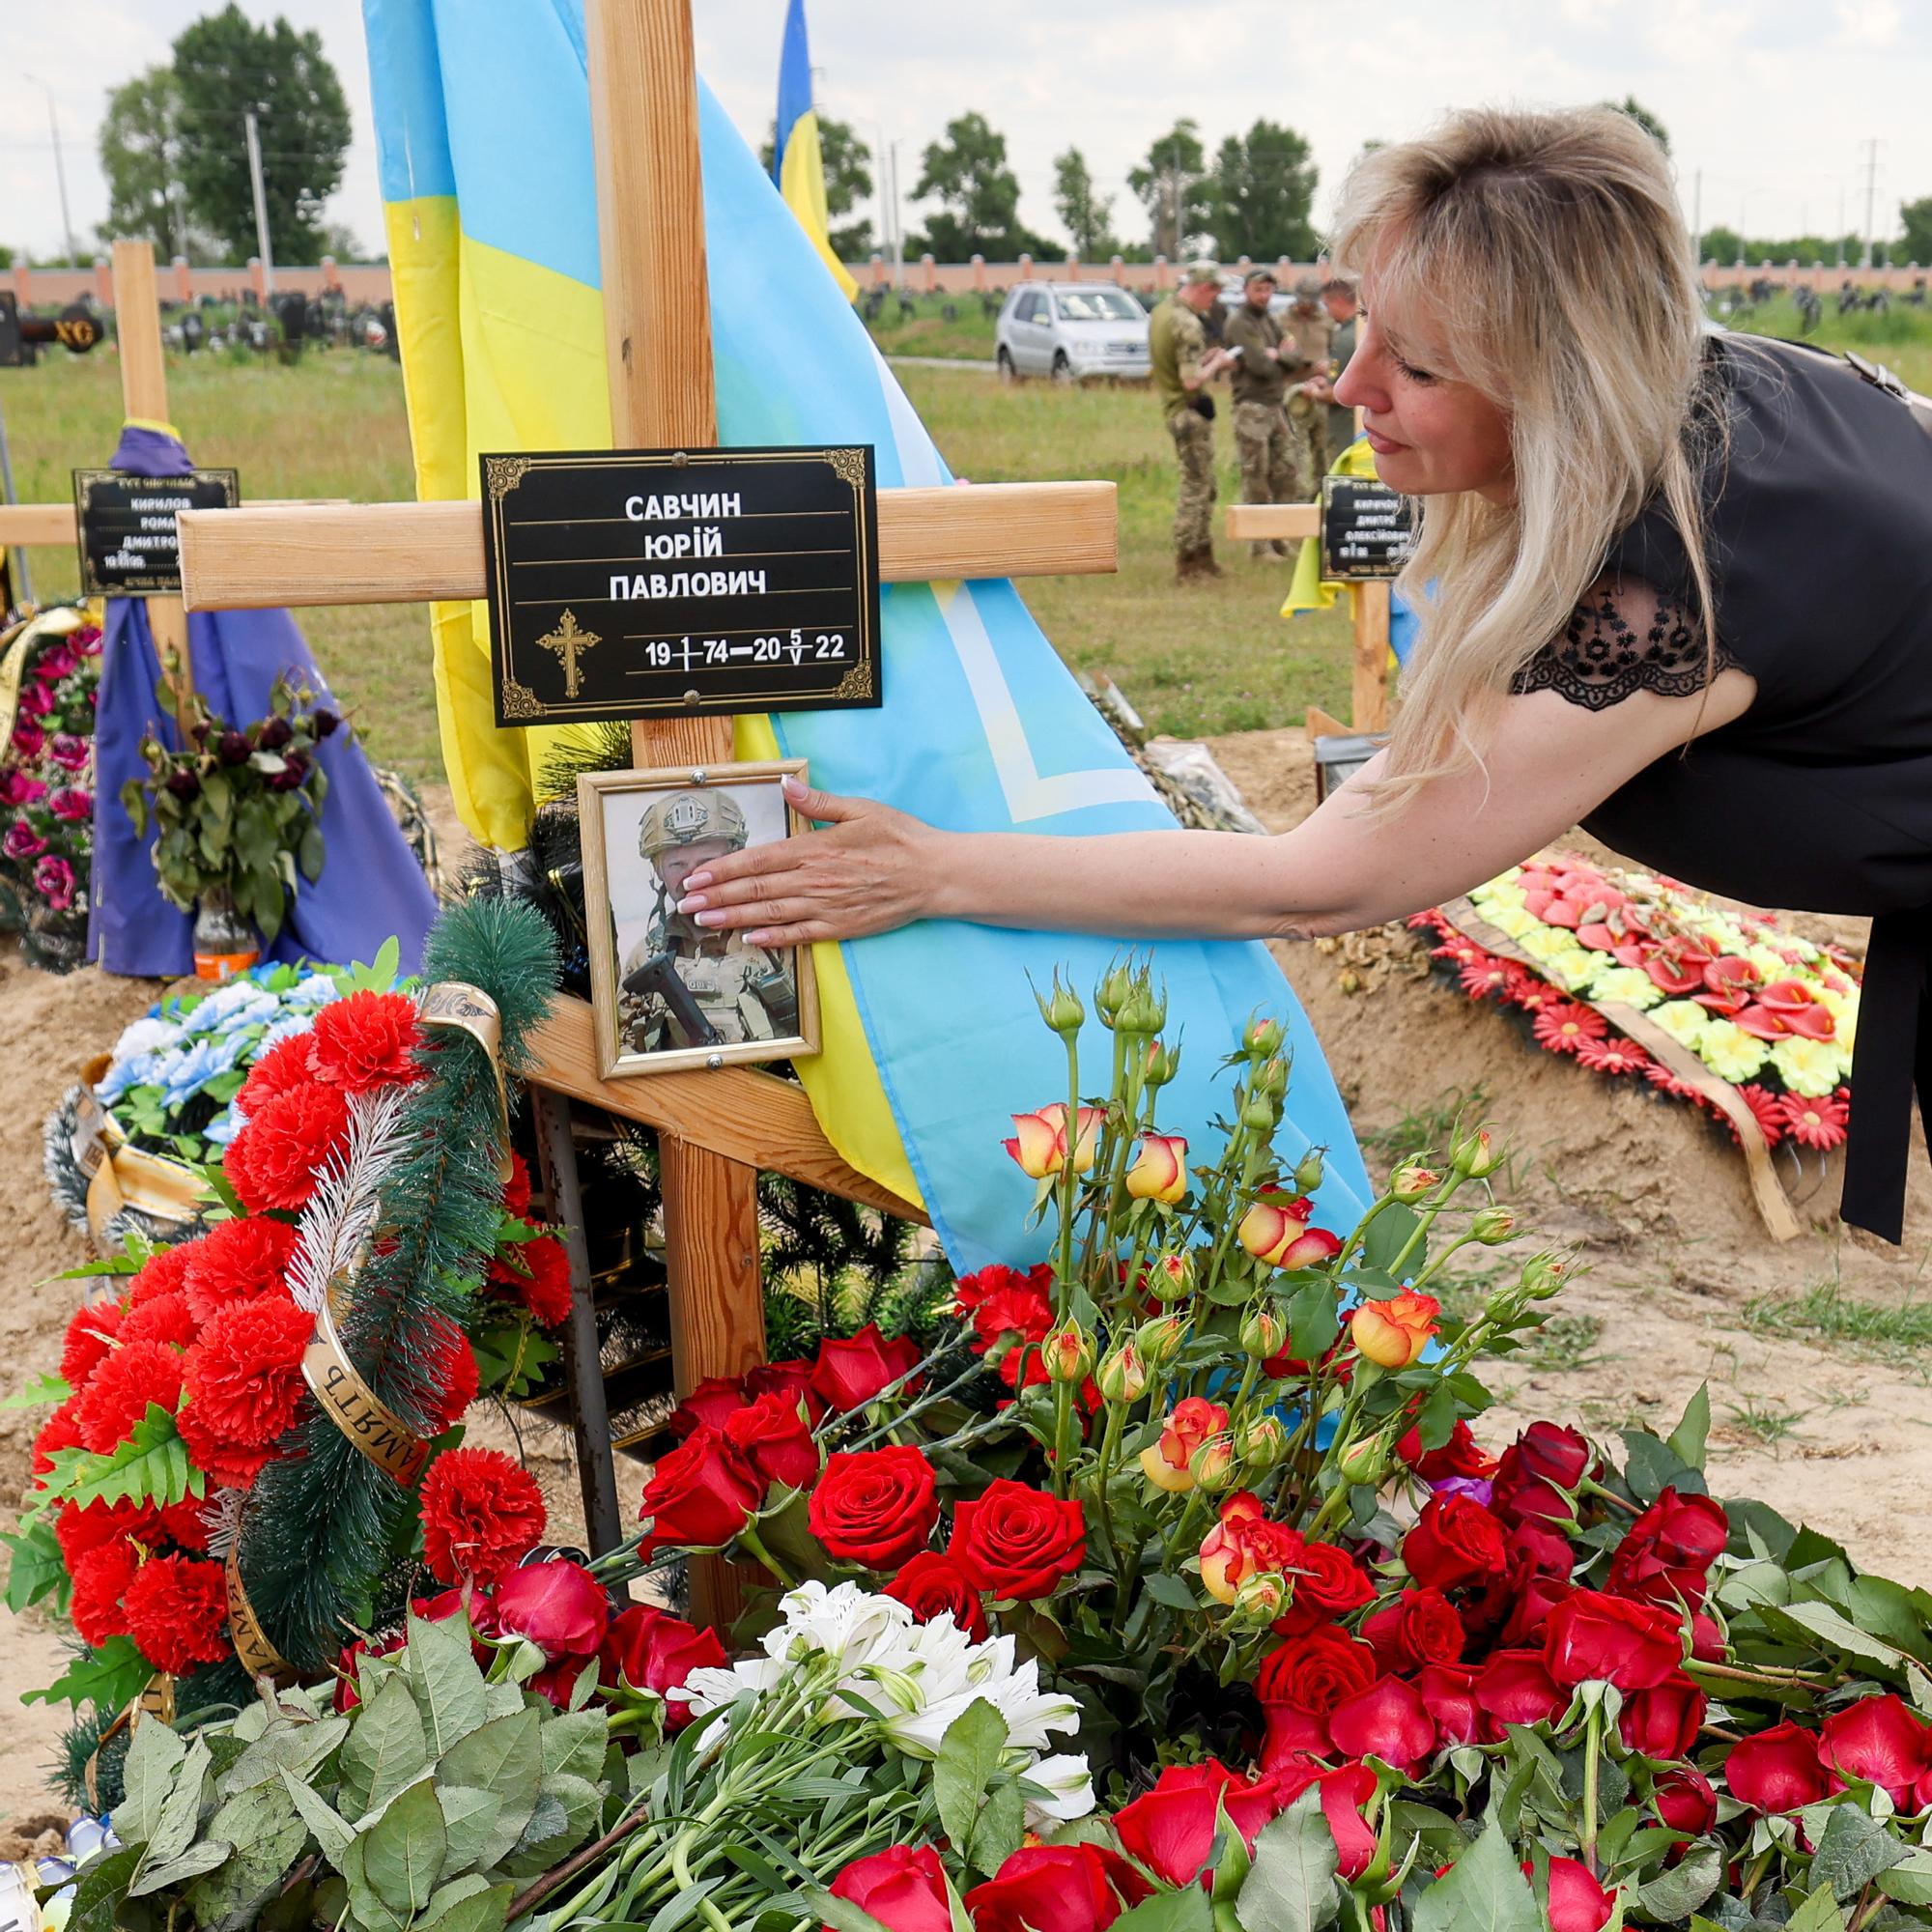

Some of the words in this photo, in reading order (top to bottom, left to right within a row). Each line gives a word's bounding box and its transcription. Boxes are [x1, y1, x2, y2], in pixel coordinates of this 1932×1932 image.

[130, 497, 192, 511] КИРИЛОВ
[625, 492, 742, 522] САВЧИН
[140, 517, 177, 530] РОМА
[122, 535, 179, 552] ДМИТРО
[644, 526, 724, 560] ЮРІЙ
[610, 570, 766, 600] ПАВЛОВИЧ
[815, 634, 845, 659] 22
